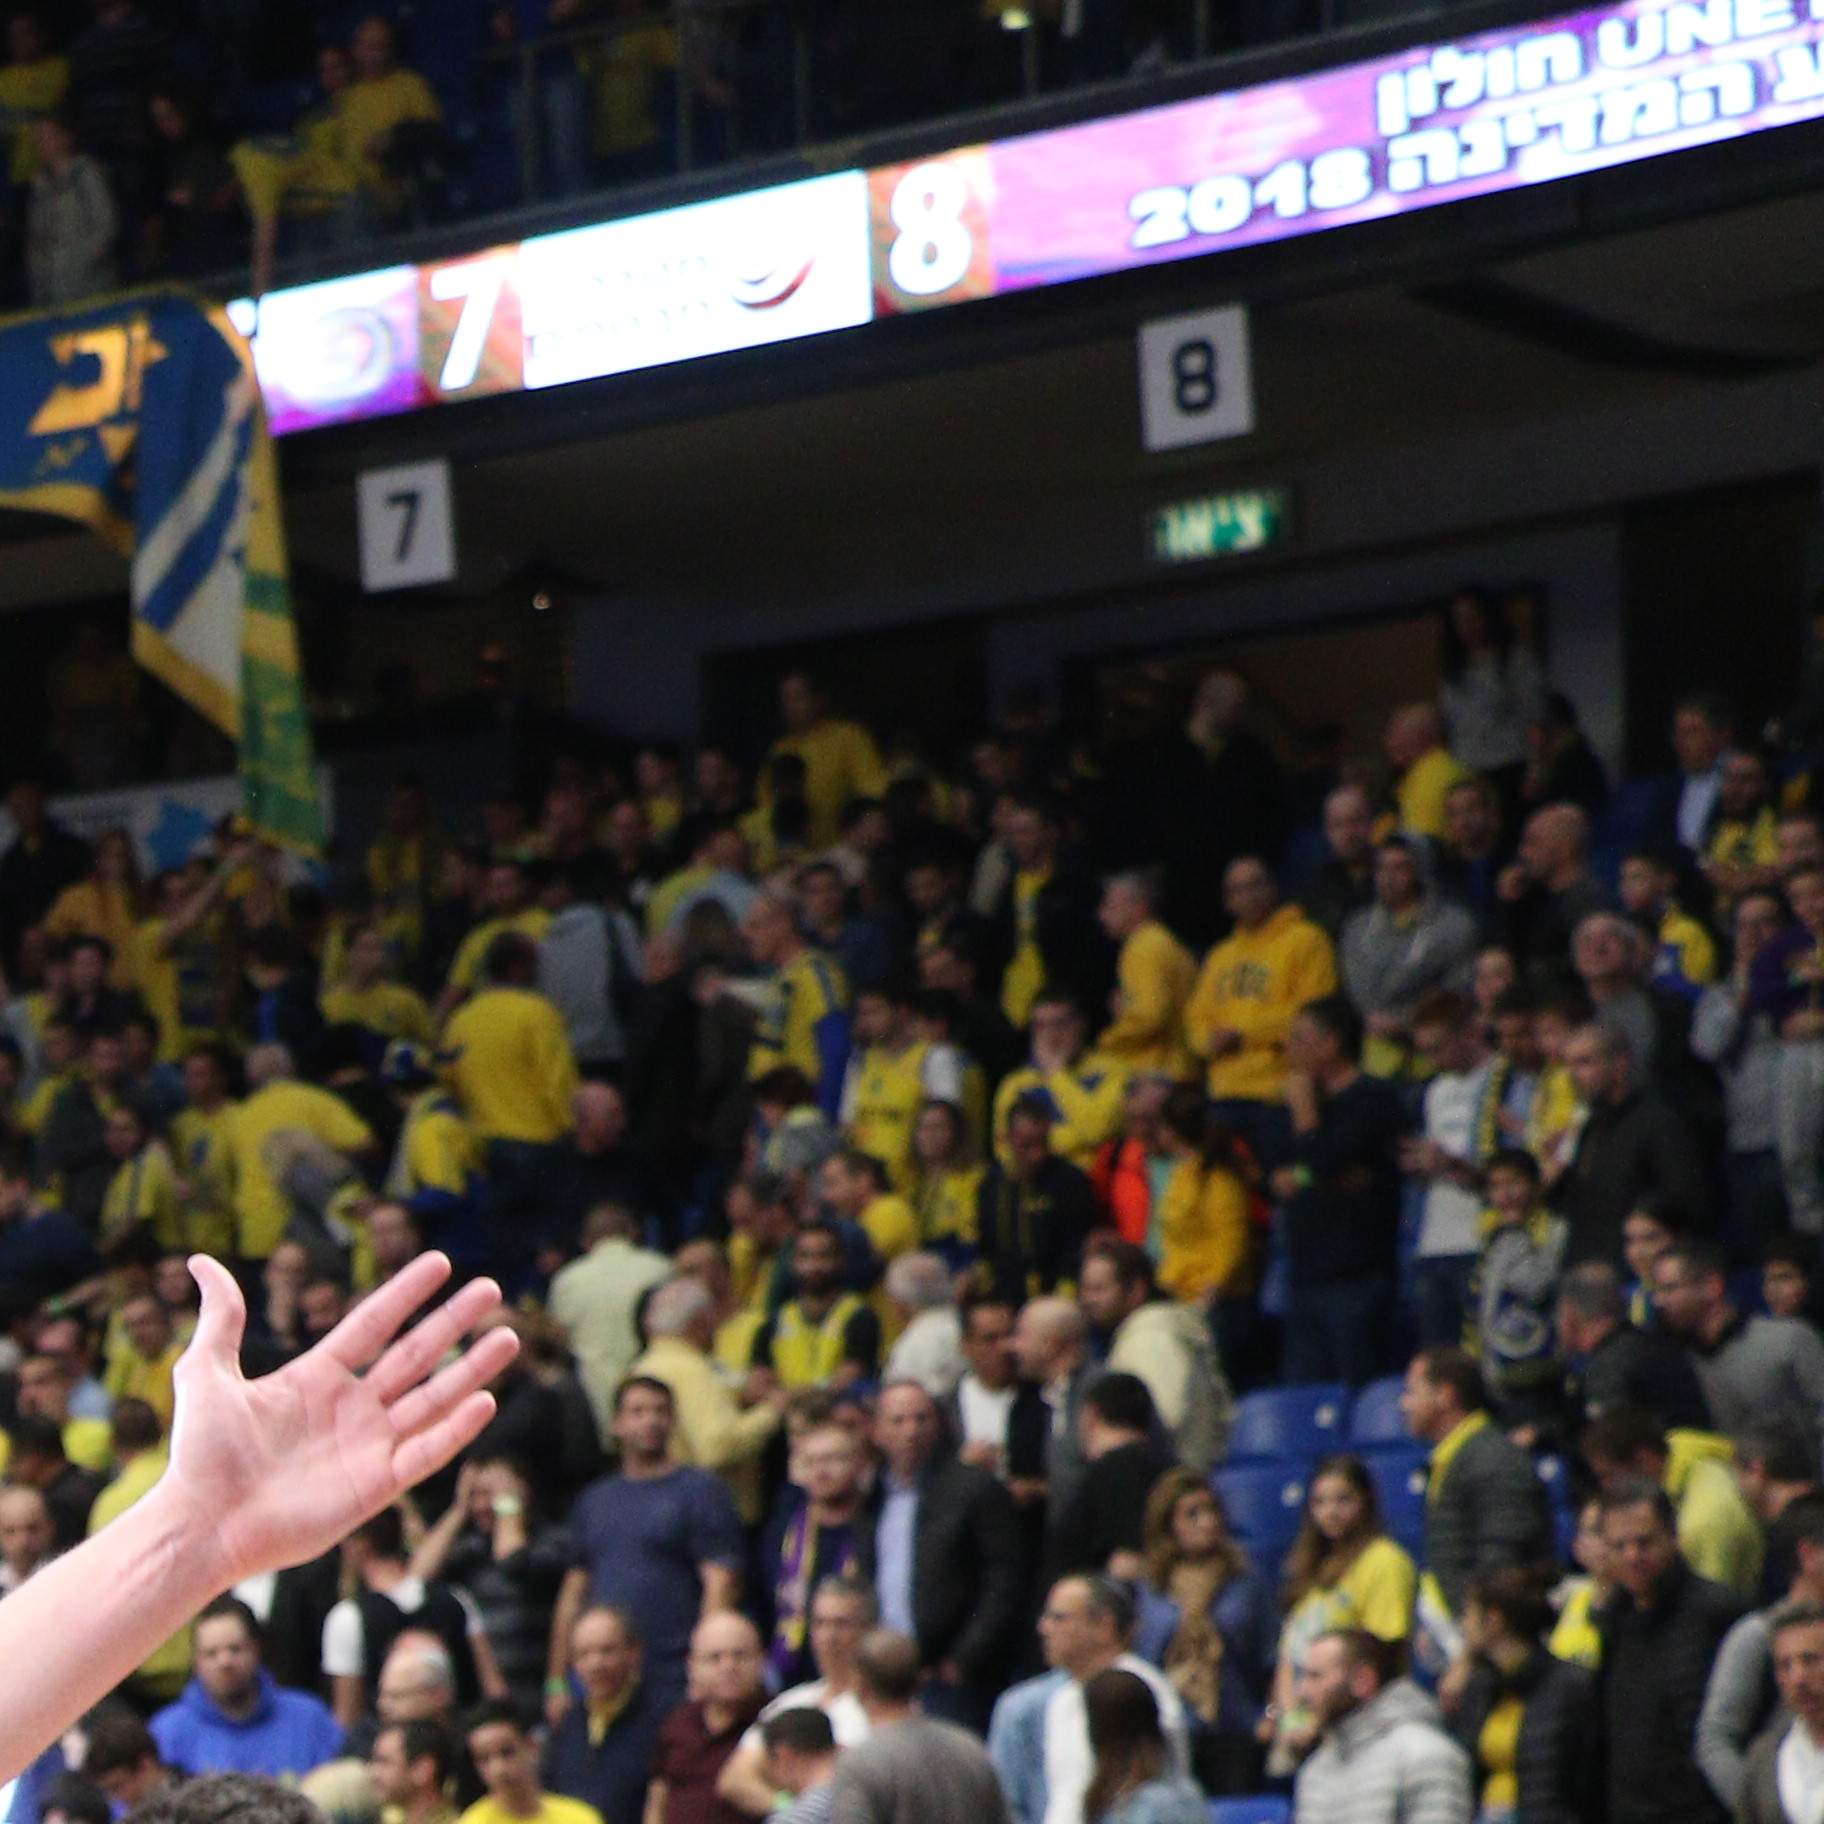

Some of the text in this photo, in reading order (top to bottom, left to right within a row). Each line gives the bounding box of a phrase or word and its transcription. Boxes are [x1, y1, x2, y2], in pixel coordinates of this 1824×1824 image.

[1378, 30, 1582, 137] חולון
[1388, 57, 1756, 192] המדינה
[888, 163, 974, 297] 8
[1128, 147, 1372, 250] 2018
[430, 259, 509, 389] 7
[1168, 337, 1218, 415] 8
[383, 490, 425, 563] 7
